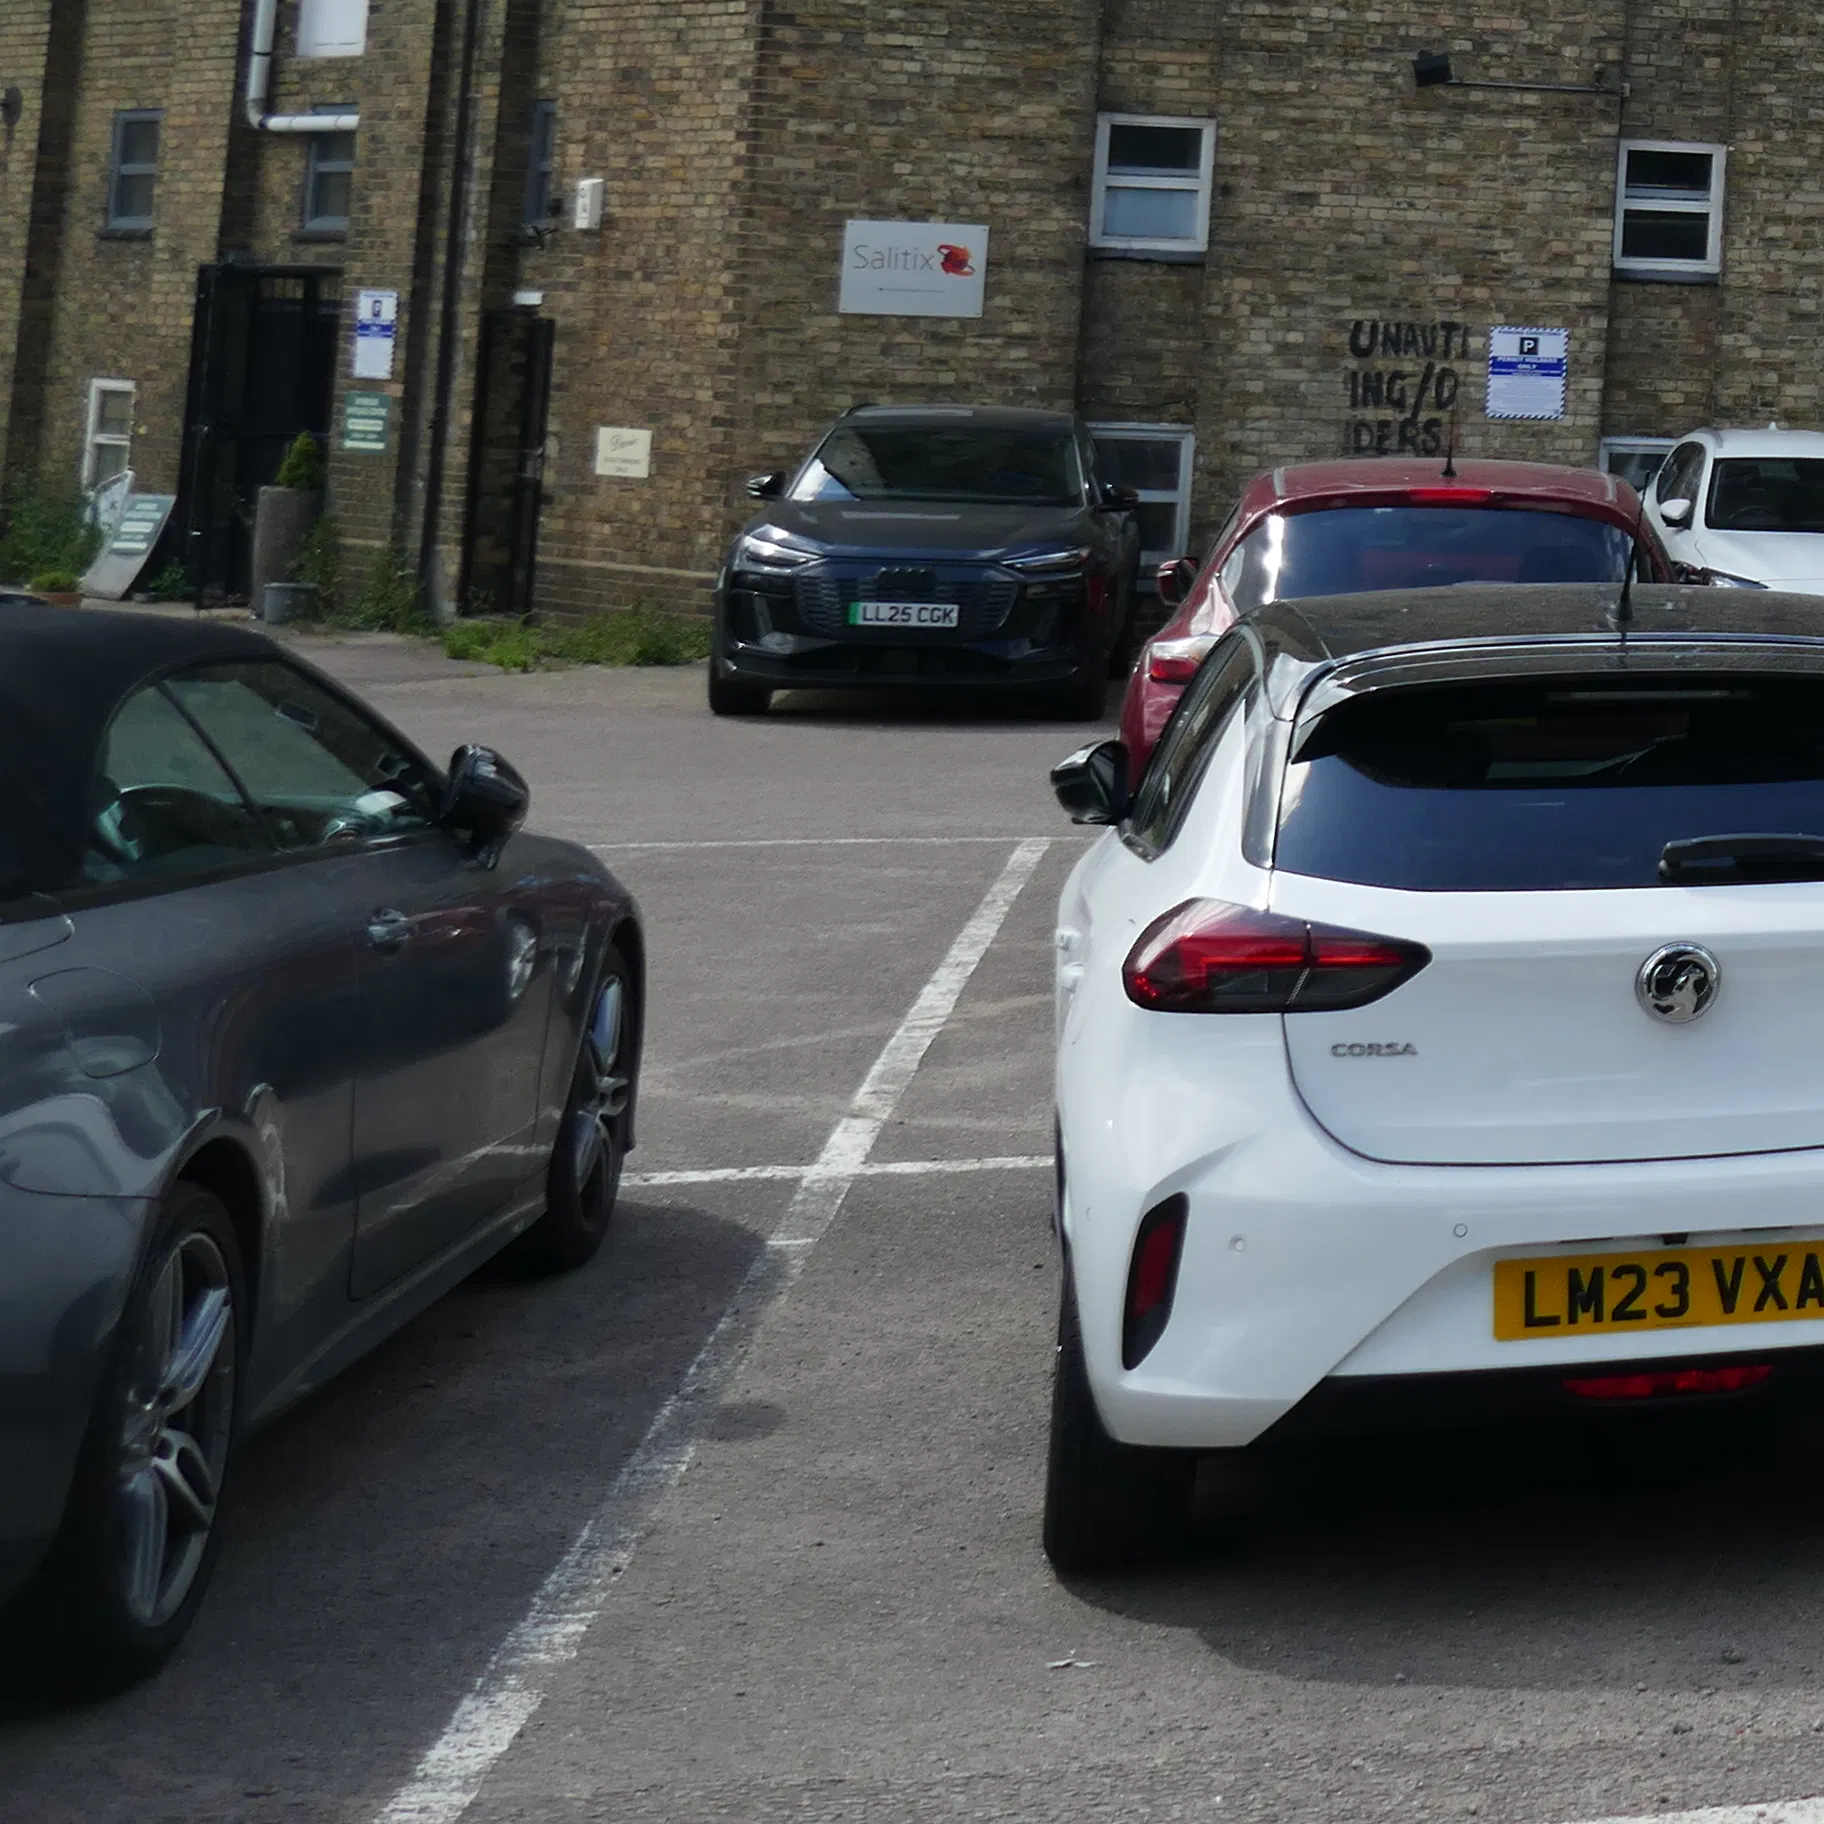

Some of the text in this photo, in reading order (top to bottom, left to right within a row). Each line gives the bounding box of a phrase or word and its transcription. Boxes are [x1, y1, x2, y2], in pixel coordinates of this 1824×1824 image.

[853, 244, 936, 271] Salitix
[863, 605, 954, 624] LL25 CGK
[1331, 1042, 1419, 1057] CORSA
[1524, 1261, 1691, 1328] LM23
